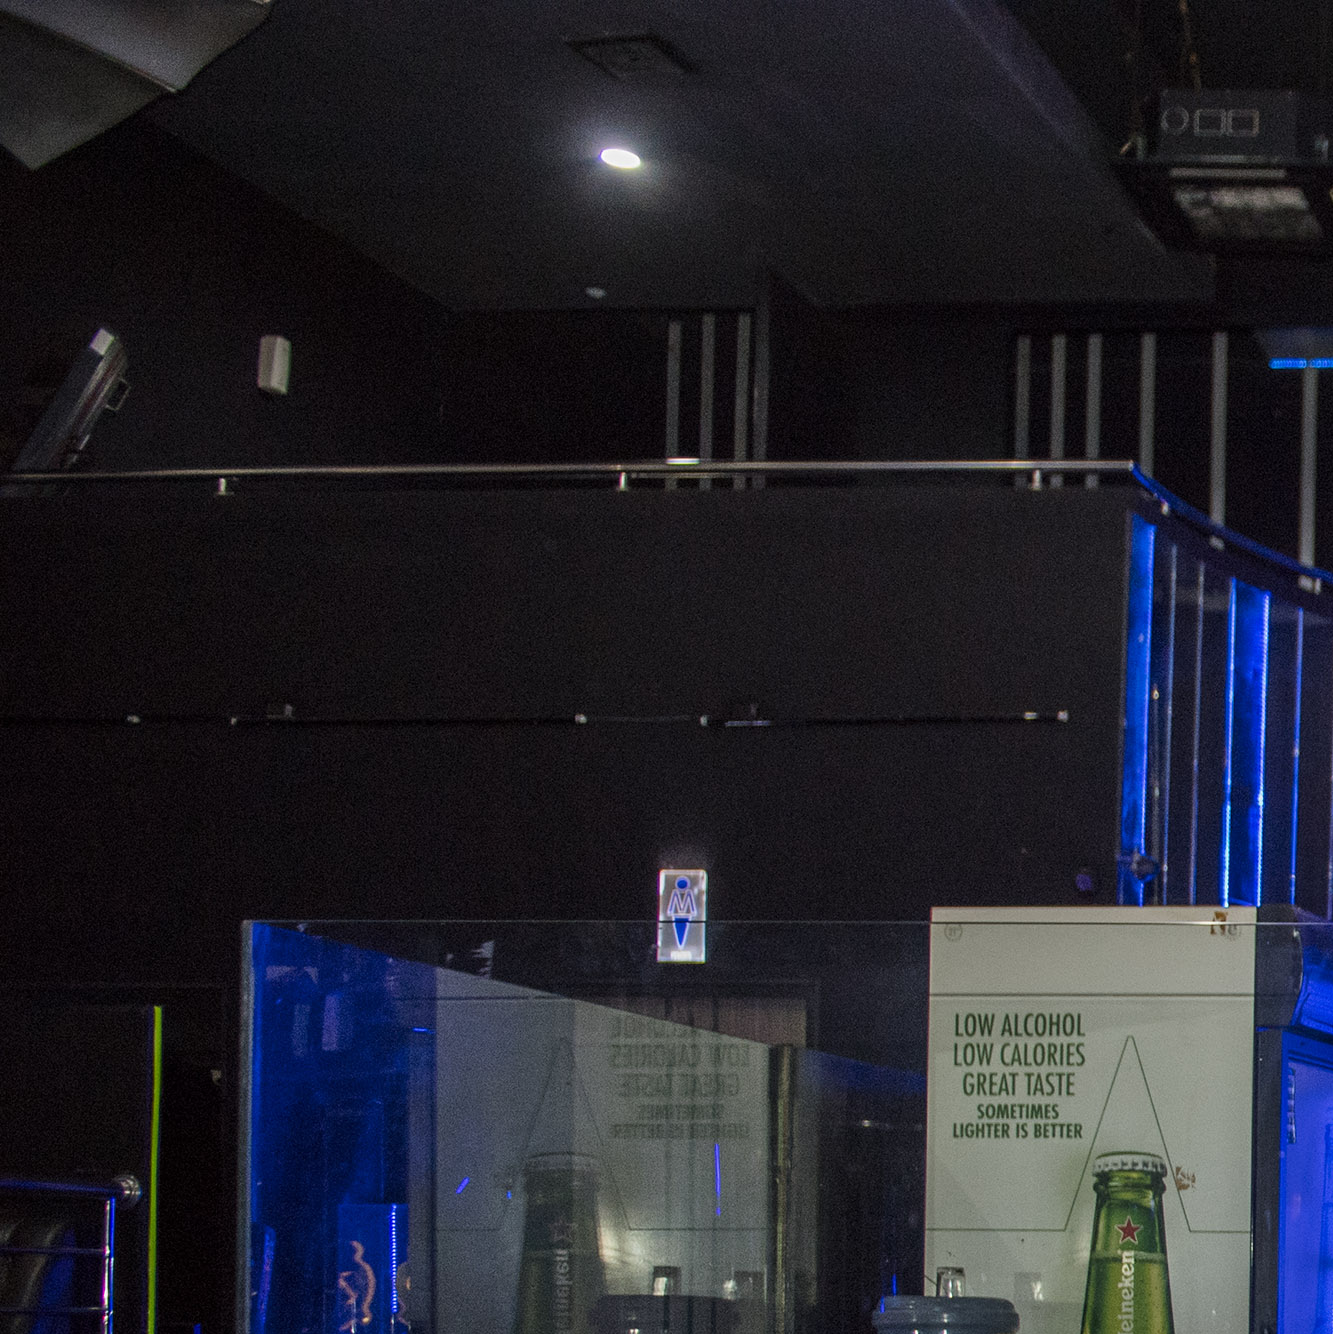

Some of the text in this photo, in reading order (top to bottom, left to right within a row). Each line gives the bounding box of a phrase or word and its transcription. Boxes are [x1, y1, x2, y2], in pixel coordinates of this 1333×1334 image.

[955, 1013, 1085, 1037] LOW ALCOHOL
[954, 1043, 1085, 1067] LOW CALORIES
[963, 1072, 1075, 1096] GREAT TASTE
[977, 1104, 1059, 1119] SOMETIMES
[953, 1123, 1083, 1139] LIGHTER IS BETTER
